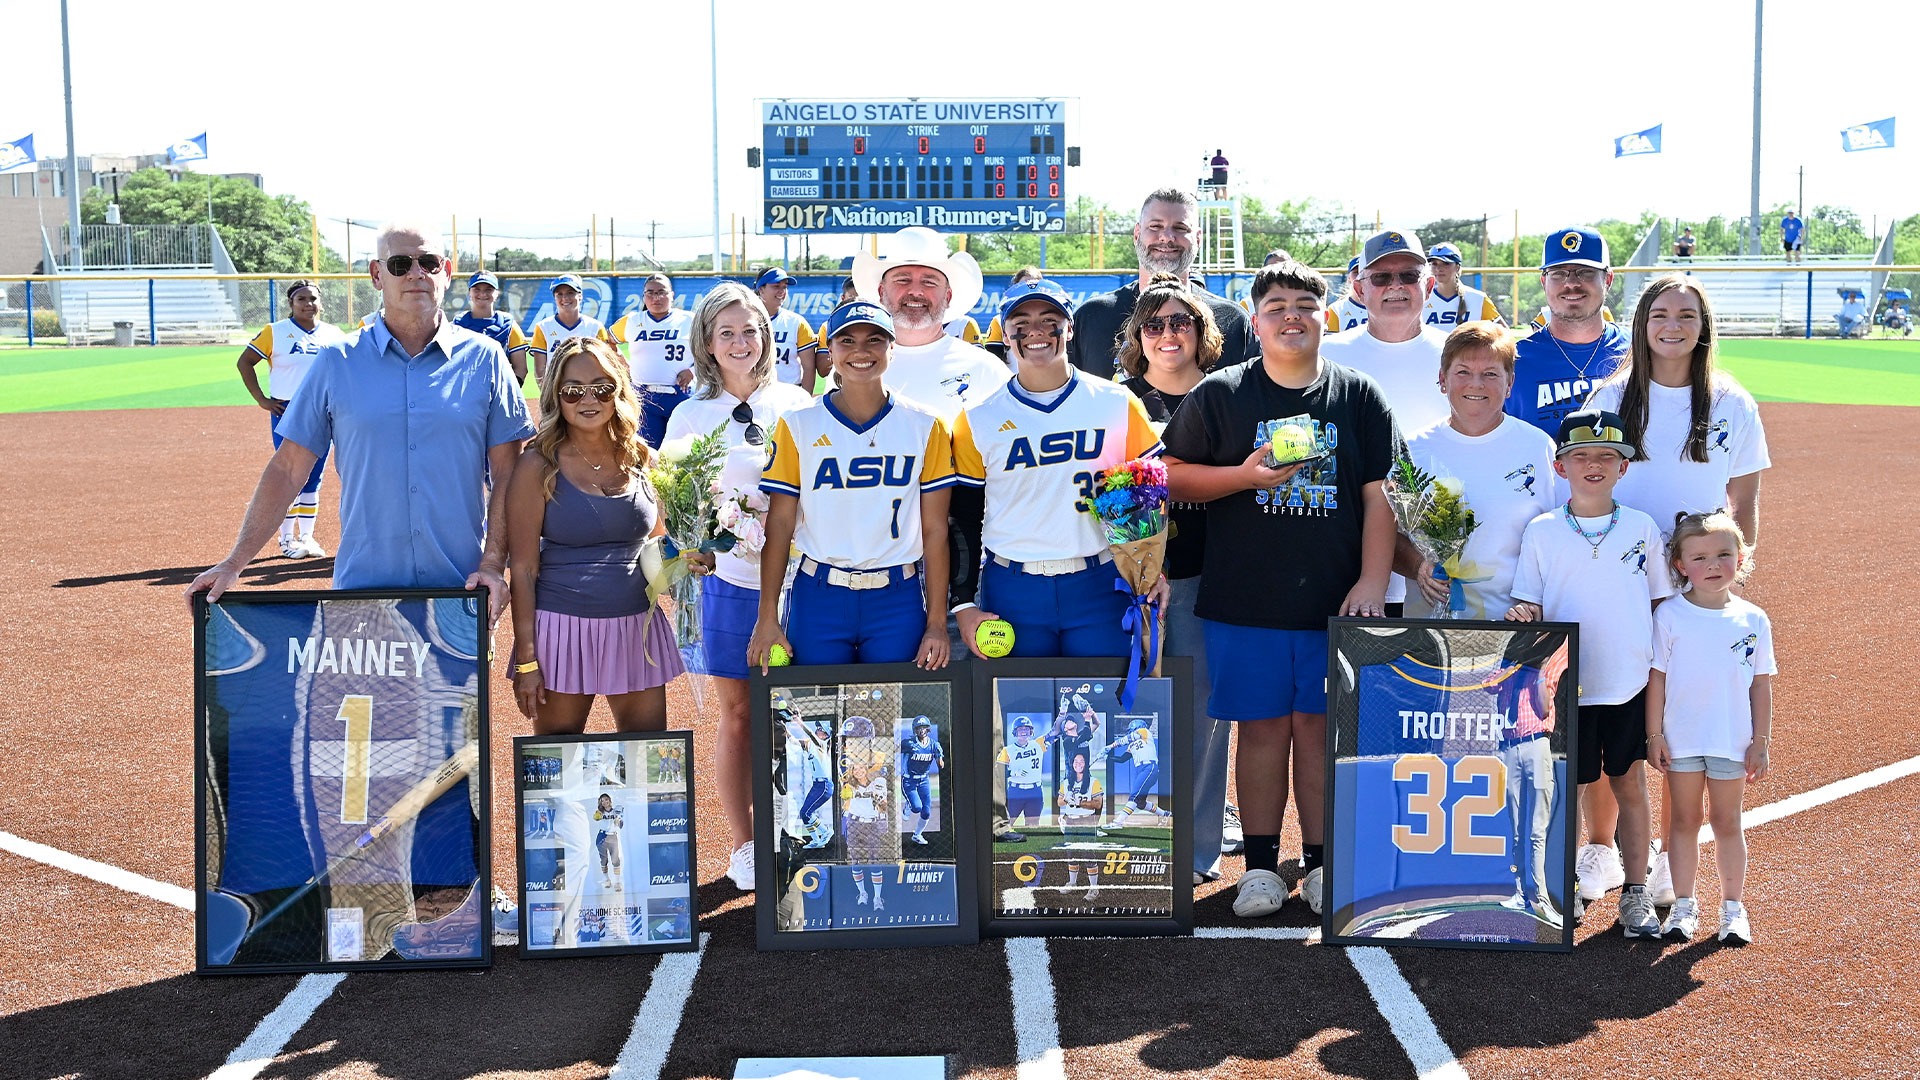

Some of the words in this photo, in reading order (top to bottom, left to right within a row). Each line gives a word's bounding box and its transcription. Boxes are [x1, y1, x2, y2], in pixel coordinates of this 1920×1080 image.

[769, 104, 857, 121] ANGELO
[864, 104, 928, 121] STATE
[935, 103, 1058, 120] UNIVERSITY
[776, 126, 789, 137] AT
[796, 126, 816, 137] BAT
[846, 126, 872, 137] BALL
[907, 125, 940, 136] STRIKE
[970, 125, 989, 136] OUT
[1034, 125, 1051, 135] H/E
[854, 137, 864, 154] 0
[918, 136, 929, 154] 0
[974, 136, 985, 154] 0
[825, 157, 829, 166] 1
[837, 157, 844, 166] 2
[851, 157, 857, 166] 3
[870, 157, 877, 166] 4
[884, 157, 890, 166] 5
[897, 157, 904, 166] 6
[918, 157, 924, 166] 7
[931, 157, 938, 166] 8
[945, 157, 951, 166] 9
[963, 157, 972, 166] 10
[984, 156, 1005, 166] RUNS
[1018, 156, 1036, 165] HITS
[1046, 156, 1062, 165] ERR
[777, 170, 812, 179] VISITORS
[996, 165, 1005, 180] 0
[1028, 165, 1037, 180] 0
[1049, 165, 1059, 180] 0
[772, 187, 817, 196] RAMBELLES
[996, 183, 1005, 197] 0
[1028, 183, 1037, 197] 0
[1049, 183, 1059, 197] 0
[770, 205, 829, 229] 2017
[832, 207, 922, 226] National
[928, 205, 1048, 230] Runner-Up
[1426, 311, 1471, 326] ASU
[634, 329, 680, 342] ASU
[664, 344, 686, 362] 33
[1003, 429, 1106, 472] ASU
[812, 455, 916, 490] ASU
[1256, 485, 1337, 509] STATE
[1263, 505, 1328, 517] SOFTBALL
[890, 498, 902, 540] 1
[287, 637, 431, 678] MANNEY
[1399, 710, 1505, 741] TROTTER
[334, 694, 373, 825] 1
[1015, 748, 1037, 760] ASU
[1031, 757, 1040, 770] 32
[1392, 753, 1508, 857] 32
[651, 818, 688, 827] GAMEDAY
[1103, 852, 1130, 875] 32
[1130, 864, 1166, 875] TROTTER
[897, 860, 906, 884] 1
[906, 872, 944, 884] MANNEY
[526, 881, 548, 891] FINAL
[651, 875, 675, 885] FINAL
[595, 908, 612, 917] HOME
[613, 906, 641, 916] SCHEDULE
[1002, 907, 1049, 915] ANGELO
[786, 918, 832, 928] ANGELO
[842, 916, 880, 925] STATE
[889, 914, 951, 923] SOFTBALL
